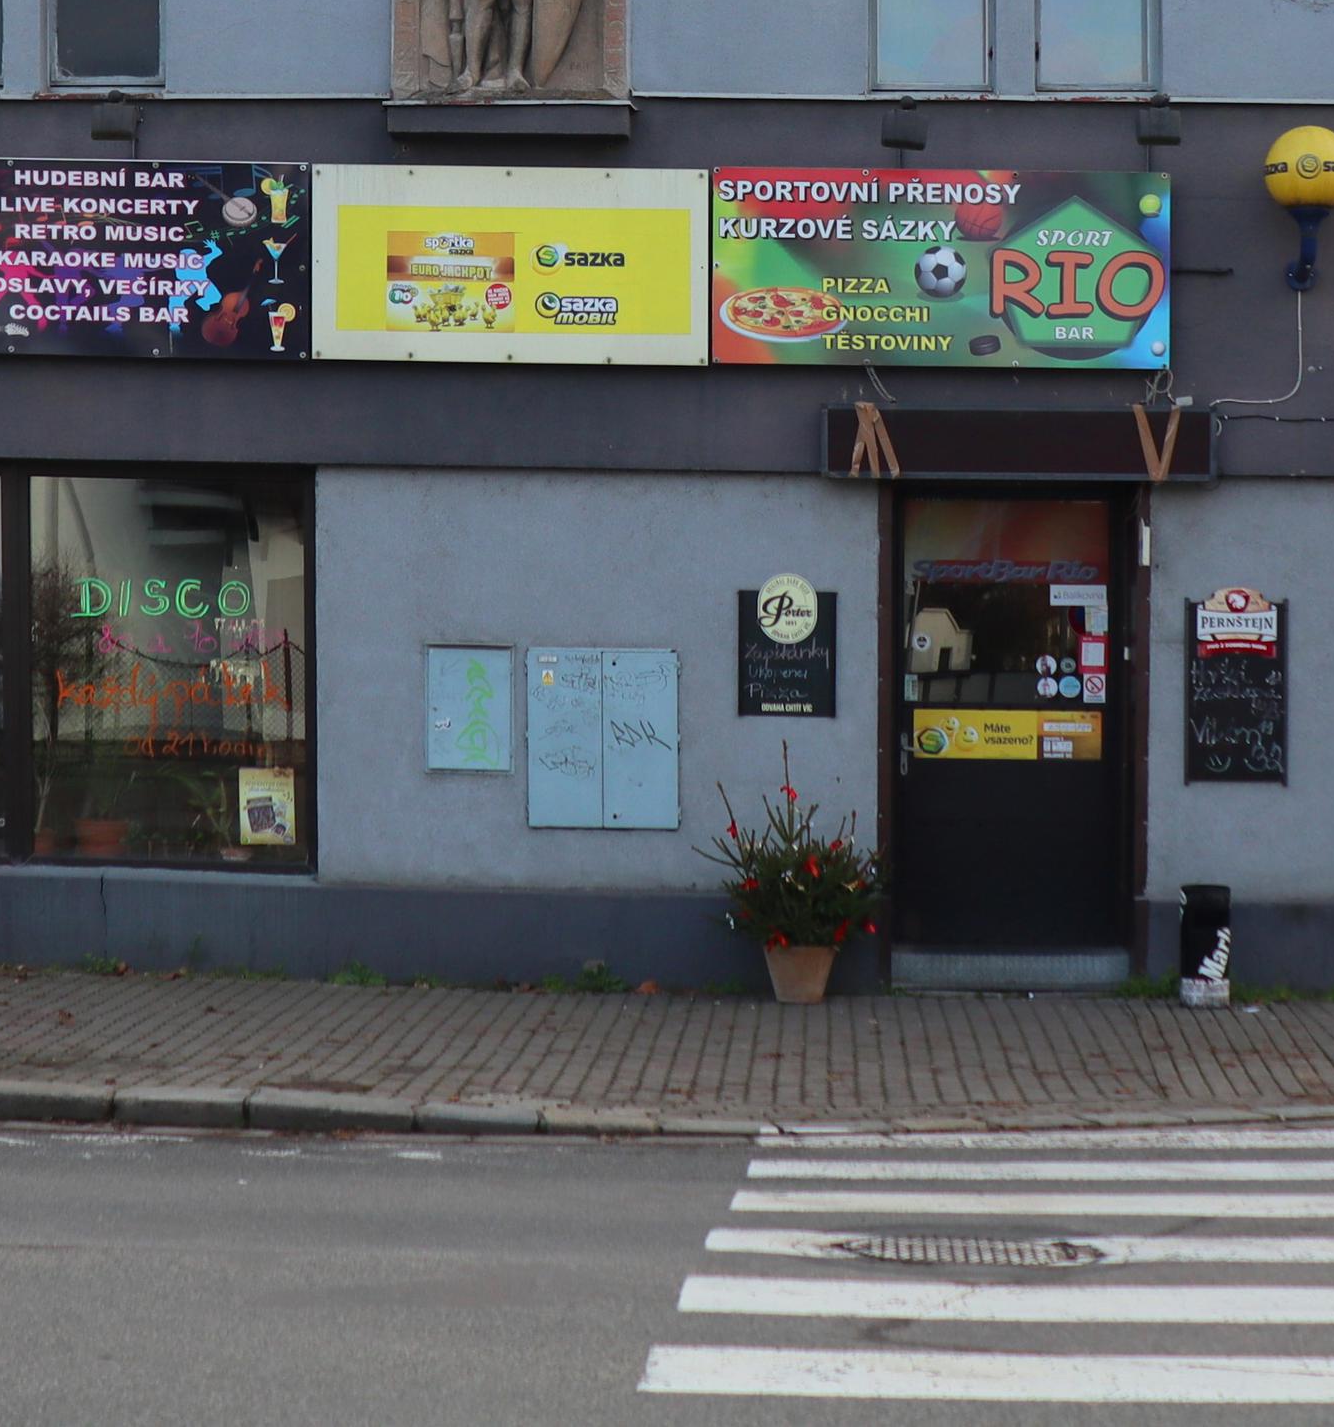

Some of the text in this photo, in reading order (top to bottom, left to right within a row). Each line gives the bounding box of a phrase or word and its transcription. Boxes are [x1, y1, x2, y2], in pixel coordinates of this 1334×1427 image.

[14, 168, 185, 188] HUDEBNÍ BAR
[718, 179, 1022, 205] SPORTOVNÍ PŘENOSY
[0, 197, 199, 216] LIVE KONCERTY
[14, 224, 185, 242] RETRO MUSIC
[718, 215, 956, 242] KURZOVÉ SÁZKY
[1035, 229, 1113, 247] SPORT
[123, 252, 204, 270] MUSIC
[98, 274, 209, 296] VEČÍRKY
[821, 277, 891, 295] PIZZA
[989, 248, 1165, 320] RIO
[9, 304, 189, 323] COCTAILS BAR
[821, 305, 930, 324] GNOCCHI
[821, 332, 953, 352] TĚSTOVINY
[1054, 326, 1095, 341] BAR
[70, 577, 252, 619] DISCO
[759, 590, 813, 627] Porter
[1200, 615, 1274, 631] PERNŠTEJN
[984, 722, 1012, 733] Máte
[984, 735, 1034, 747] vsazeno?
